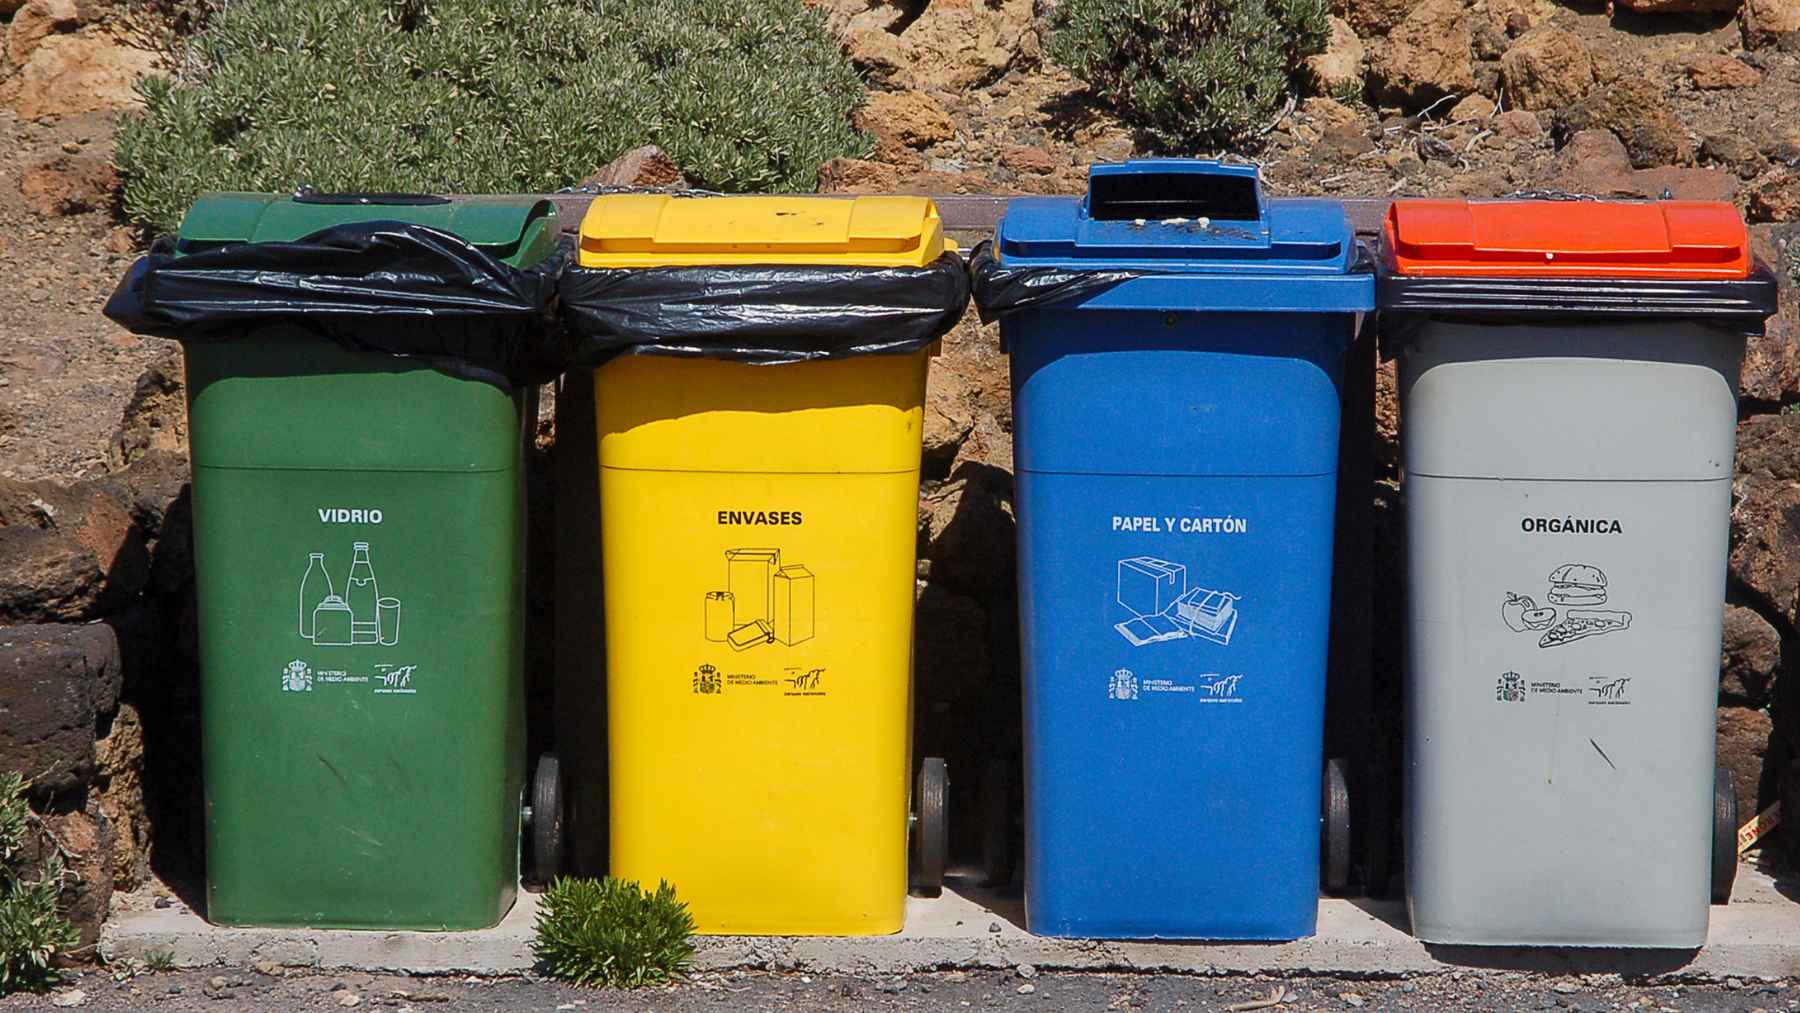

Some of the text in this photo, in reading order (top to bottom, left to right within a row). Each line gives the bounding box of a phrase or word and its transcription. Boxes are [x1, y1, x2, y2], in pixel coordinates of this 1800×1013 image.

[318, 509, 383, 523] VIDRIO
[718, 511, 802, 525] ENVASES
[1112, 515, 1246, 533] PAPEL Y CARTÓN
[1521, 515, 1622, 534] ORGÁNICA
